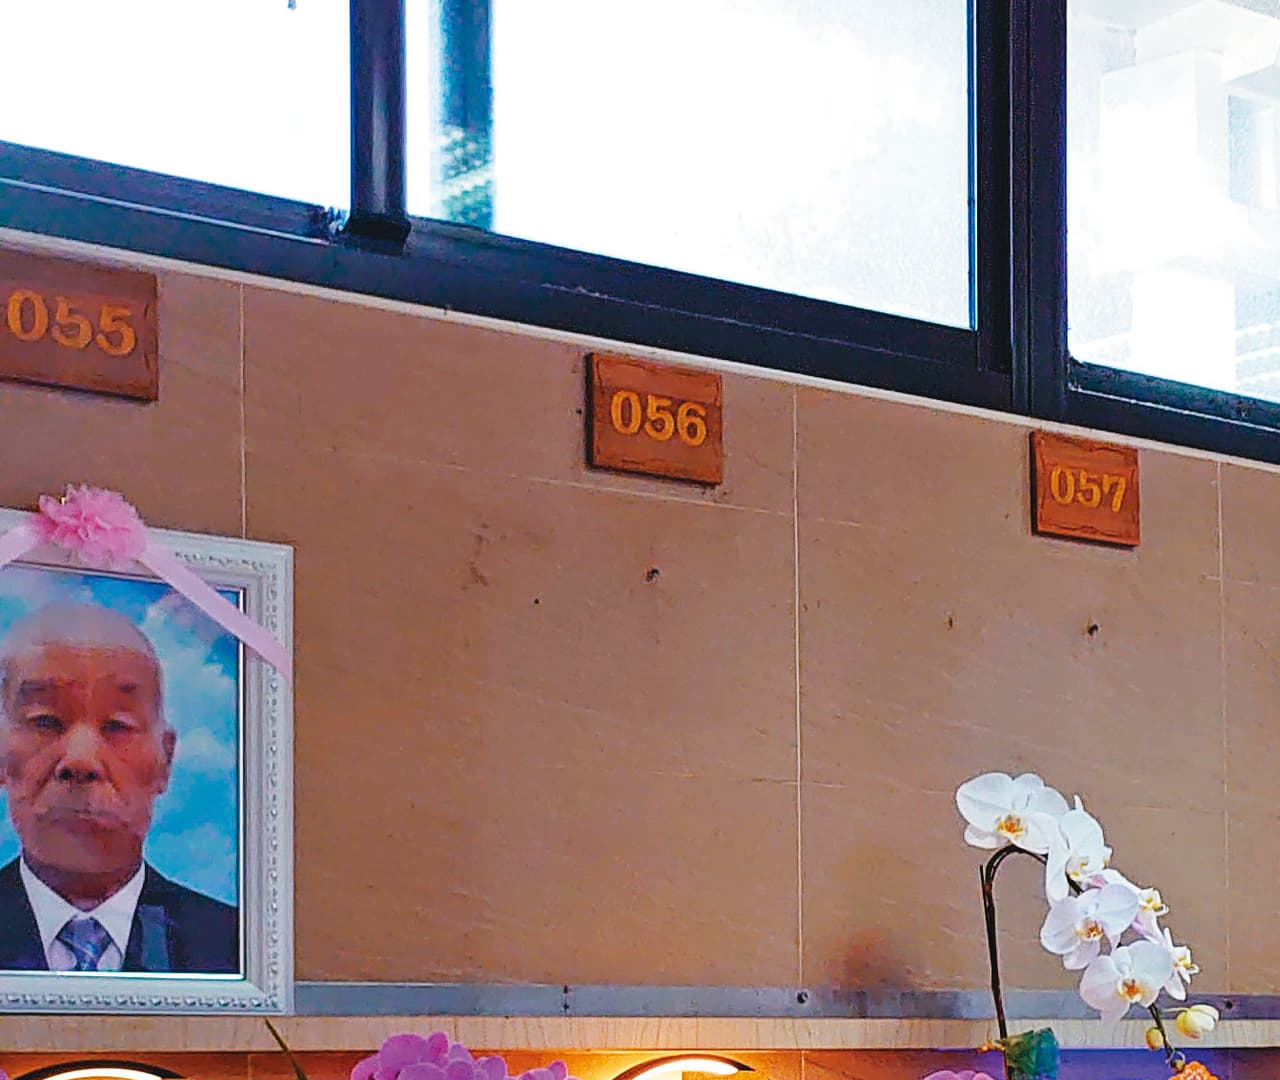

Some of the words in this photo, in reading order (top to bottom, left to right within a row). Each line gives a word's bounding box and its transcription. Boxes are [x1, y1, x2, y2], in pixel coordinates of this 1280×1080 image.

[7, 289, 137, 357] 055
[610, 390, 707, 447] 056
[1049, 466, 1126, 514] 057
